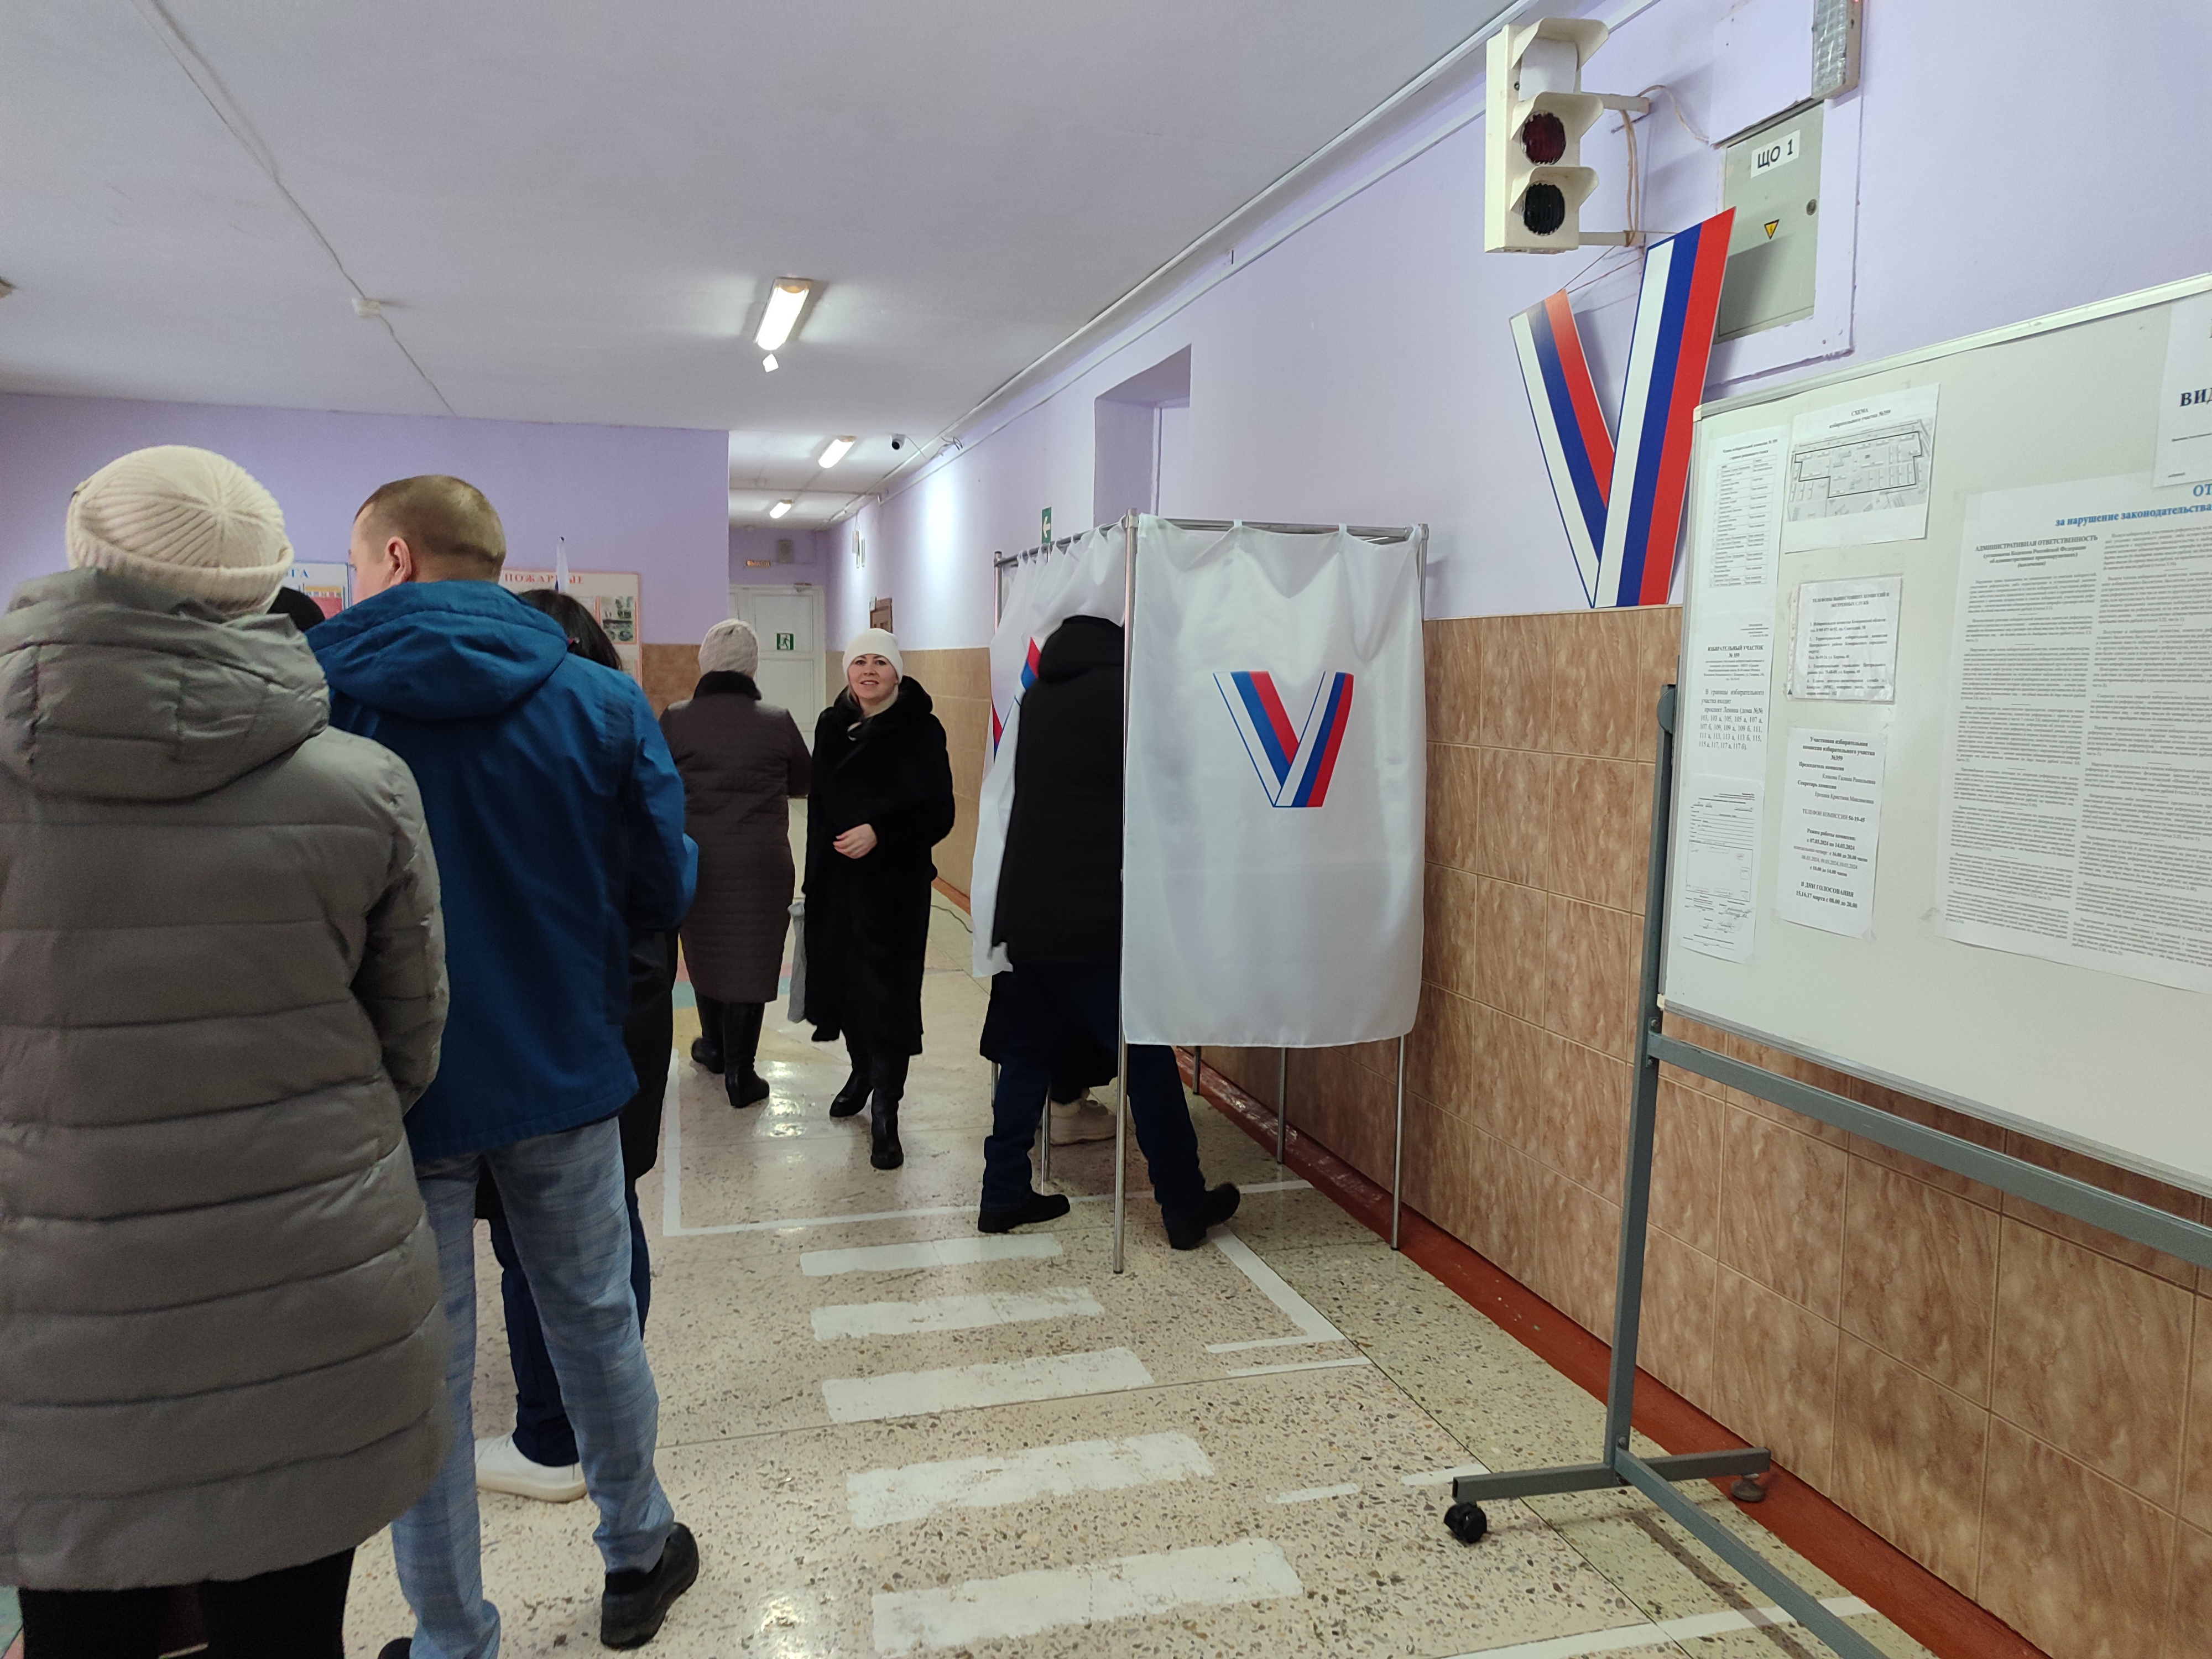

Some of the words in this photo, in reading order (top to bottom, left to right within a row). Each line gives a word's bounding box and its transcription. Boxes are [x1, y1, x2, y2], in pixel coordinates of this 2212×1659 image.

[1757, 145, 1781, 169] ЩО
[1787, 138, 1793, 155] 1
[2067, 513, 2119, 527] нарушение
[2120, 503, 2211, 520] законодательства
[1975, 540, 2037, 552] АДМИНИСТРАТИВНАЯ
[2038, 535, 2098, 546] ОТВЕТСТВЕННОСТЬ
[1797, 780, 1818, 788] Секретарь
[1822, 812, 1848, 820] КОМИССИИ
[1816, 884, 1854, 898] ГОЛОСОВАНИЯ
